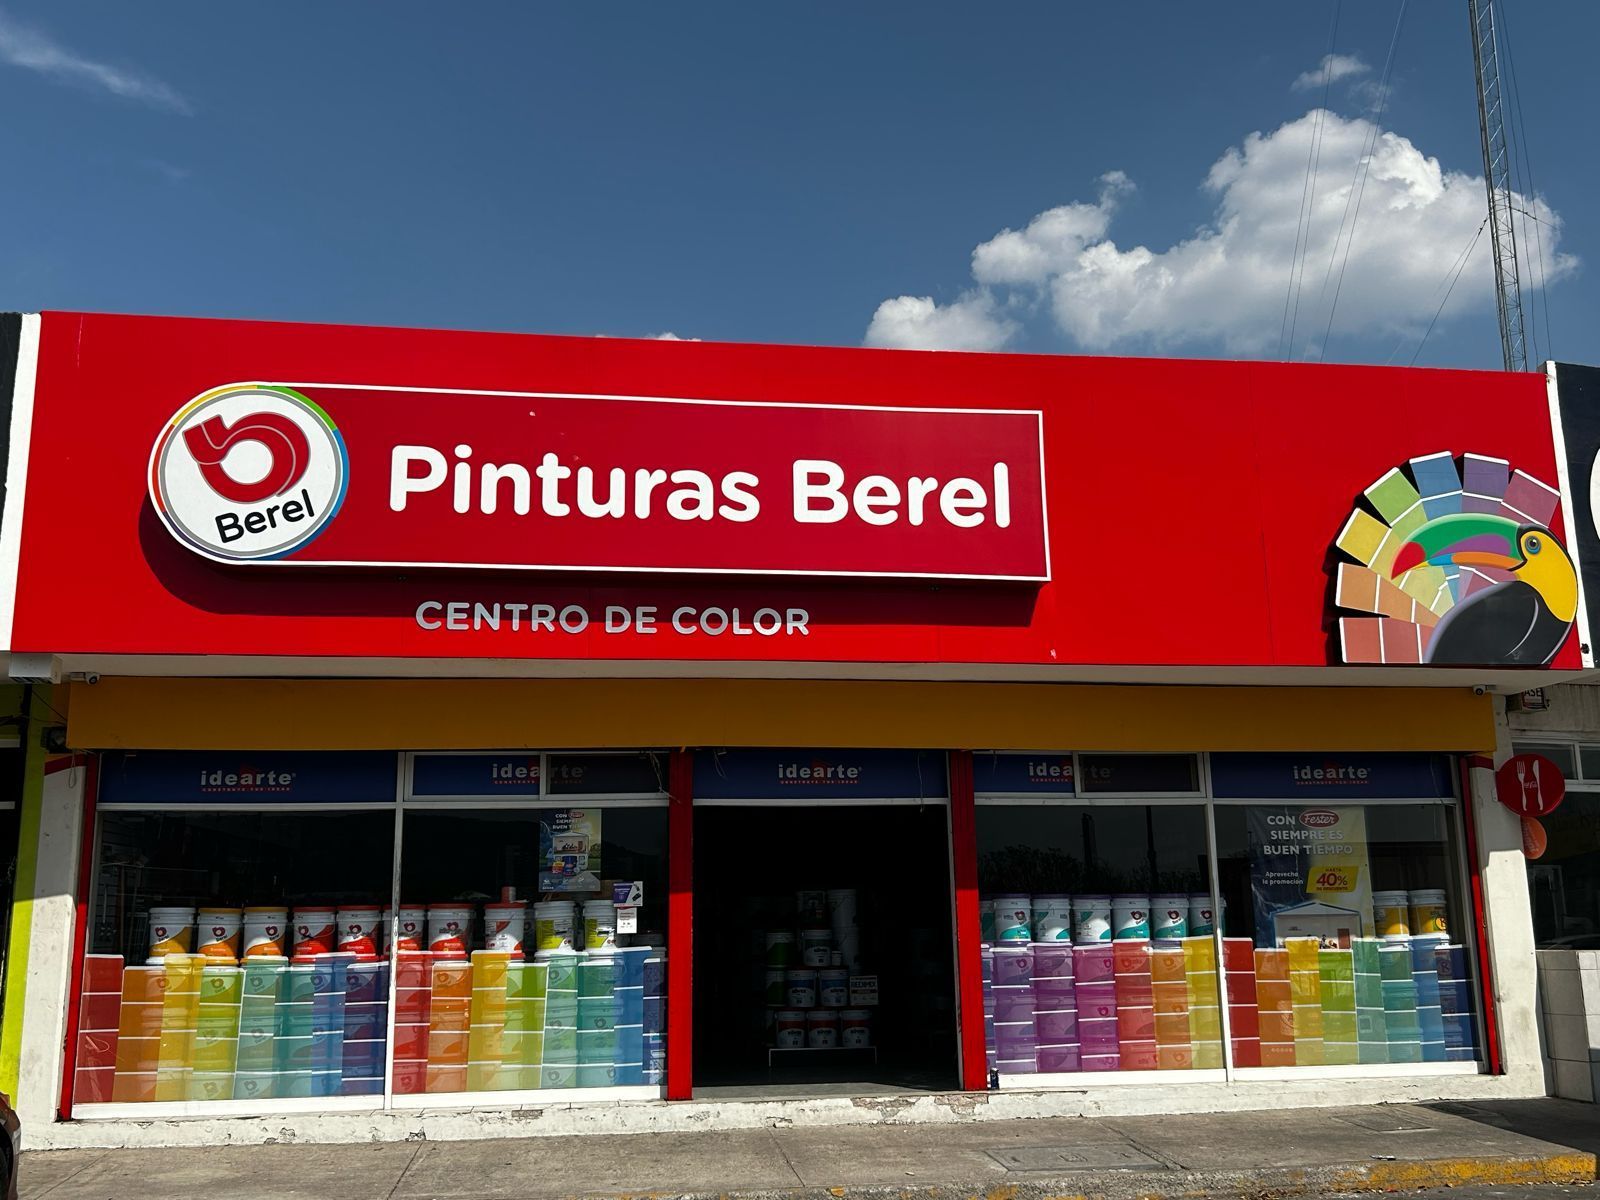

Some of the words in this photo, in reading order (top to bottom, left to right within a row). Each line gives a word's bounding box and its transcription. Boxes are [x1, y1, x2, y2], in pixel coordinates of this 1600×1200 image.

[389, 443, 761, 523] Pinturas
[792, 459, 1011, 528] Berel
[215, 488, 316, 544] Berel
[415, 600, 590, 635] CENTRO
[604, 605, 659, 635] DE
[671, 606, 811, 637] COLOR
[200, 770, 292, 785] idearte
[778, 763, 859, 778] idearte
[1293, 765, 1368, 779] idearte
[1266, 815, 1296, 825] CON
[1303, 813, 1336, 825] Fester
[1270, 830, 1325, 840] SIEMPRE
[1329, 830, 1344, 840] ES
[1263, 845, 1300, 855] BUEN
[1303, 845, 1353, 855] TIEMPO
[1316, 872, 1348, 886] 40%
